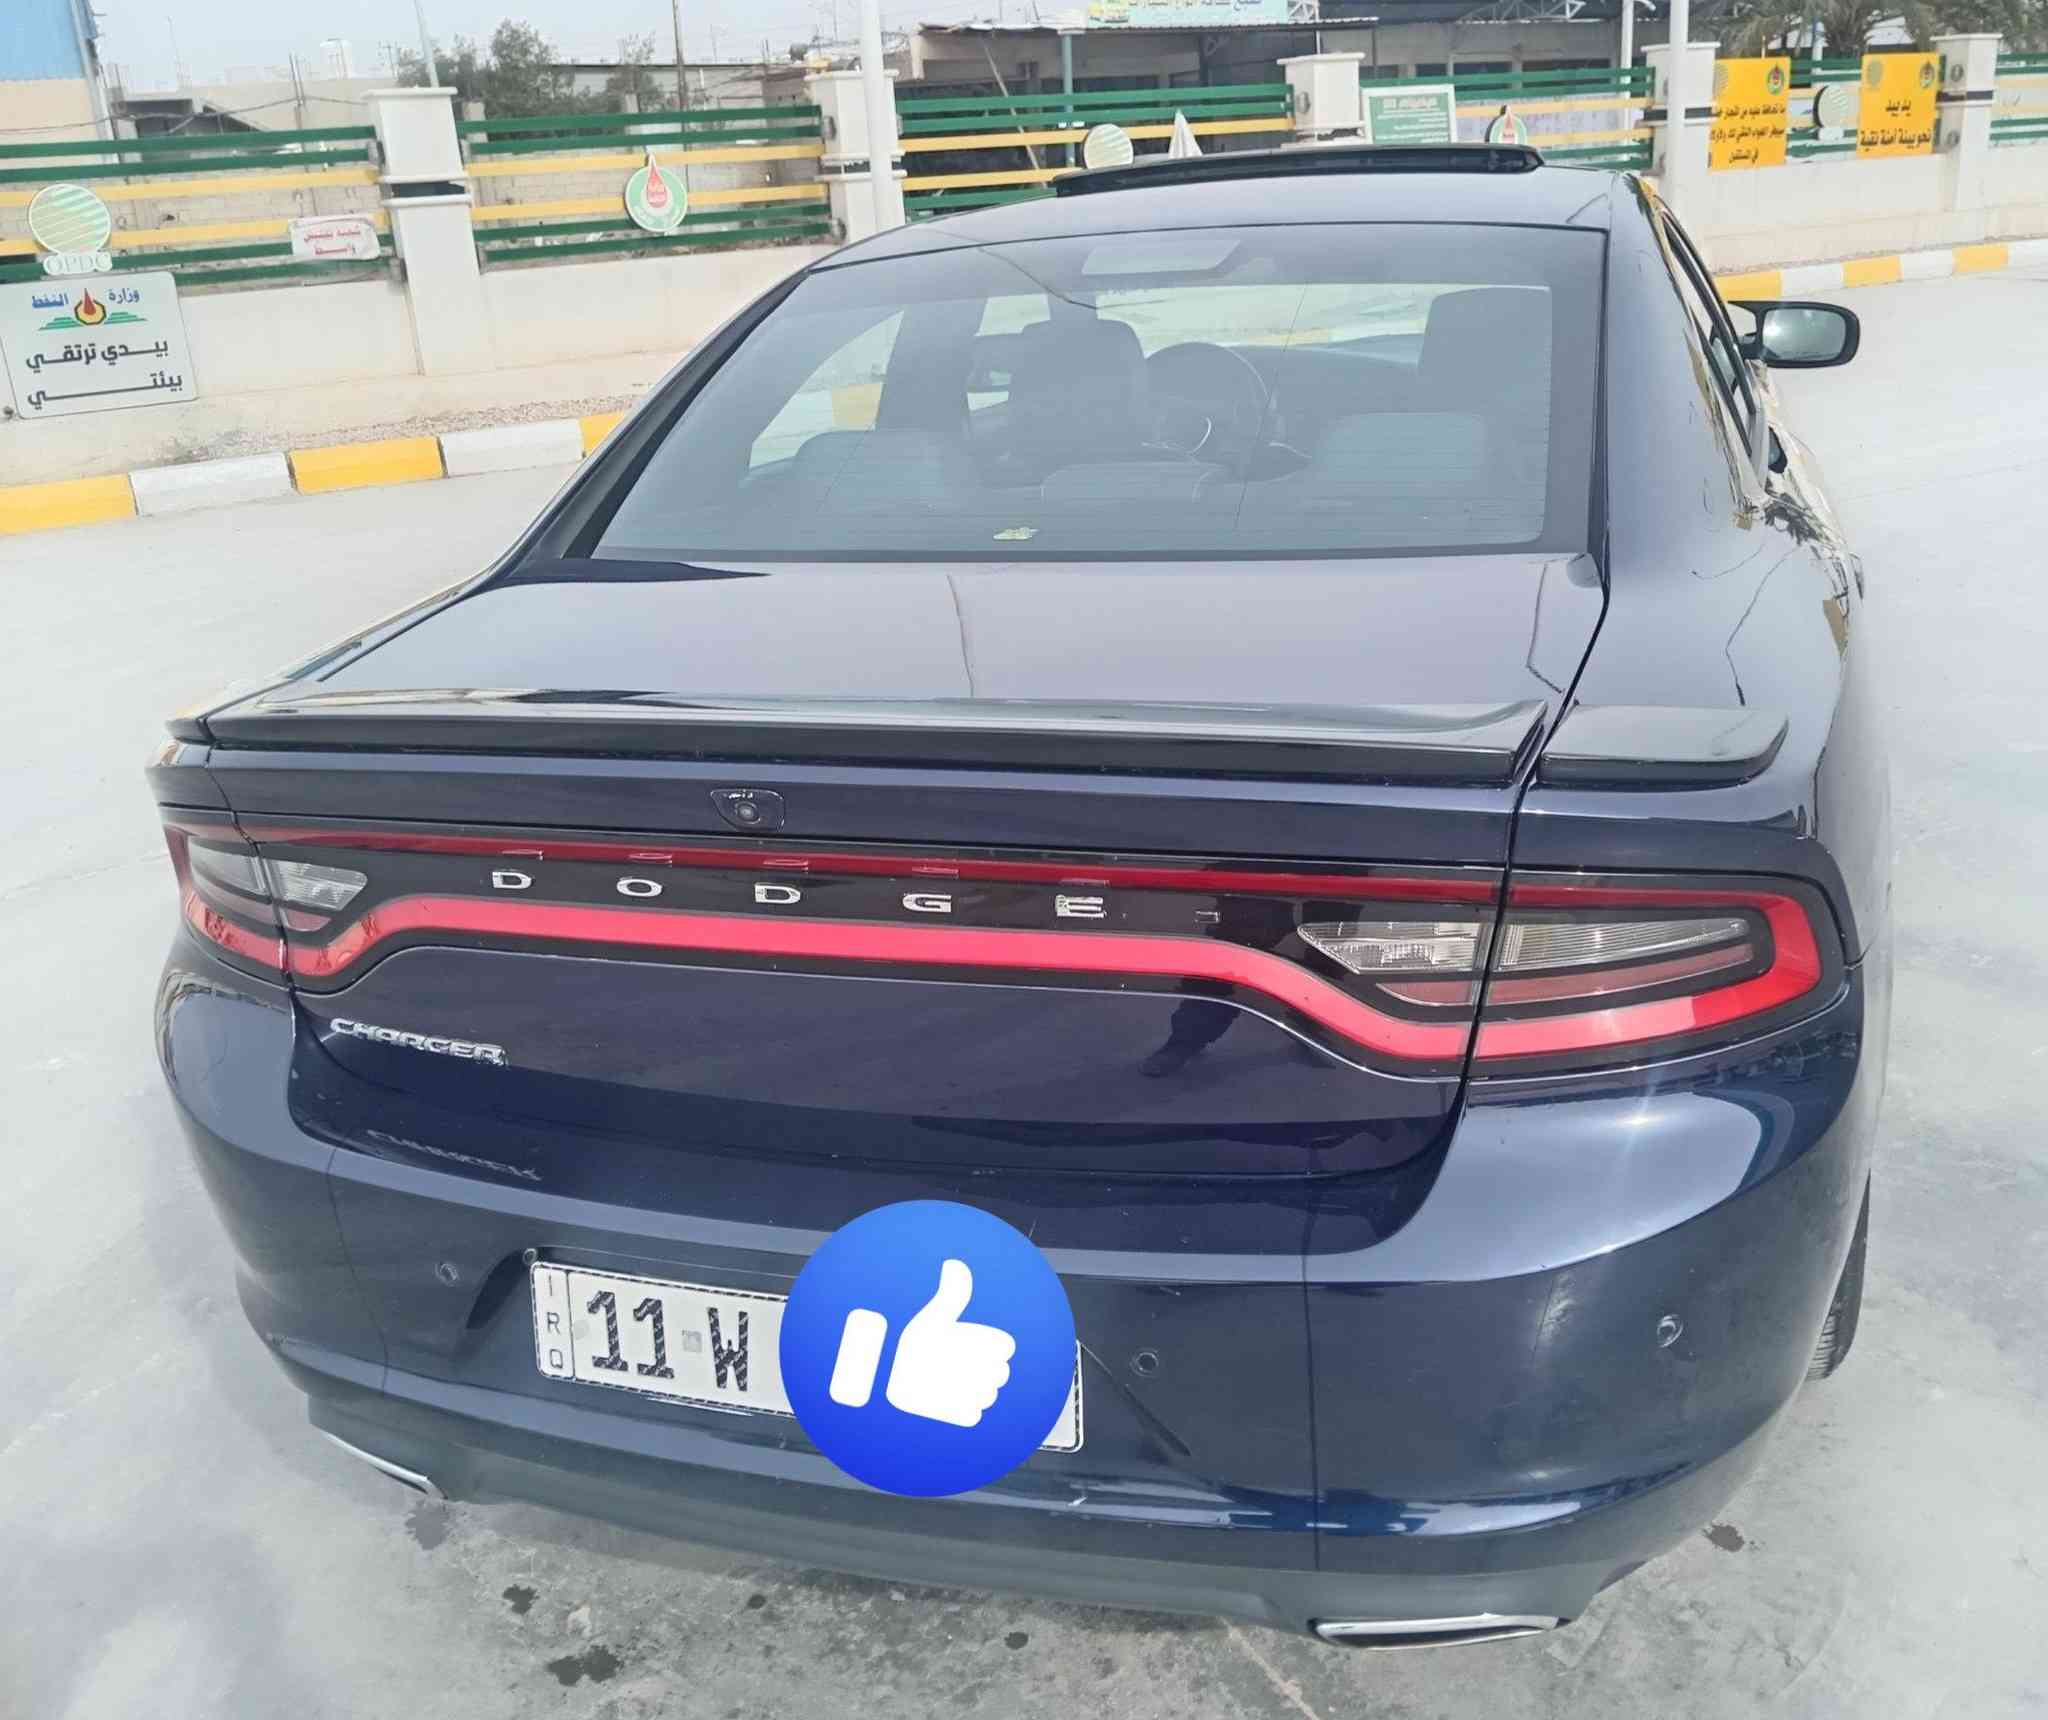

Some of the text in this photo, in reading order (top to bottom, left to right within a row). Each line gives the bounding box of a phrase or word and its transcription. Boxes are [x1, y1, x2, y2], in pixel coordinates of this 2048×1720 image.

[44, 251, 113, 275] OPDC
[32, 287, 140, 309] وزارة النفط
[26, 340, 169, 373] بيدي ترتقي
[27, 371, 183, 410] بيئتي
[492, 870, 1106, 919] DODGE
[330, 1017, 509, 1068] CHARGER
[586, 1290, 676, 1380] 11
